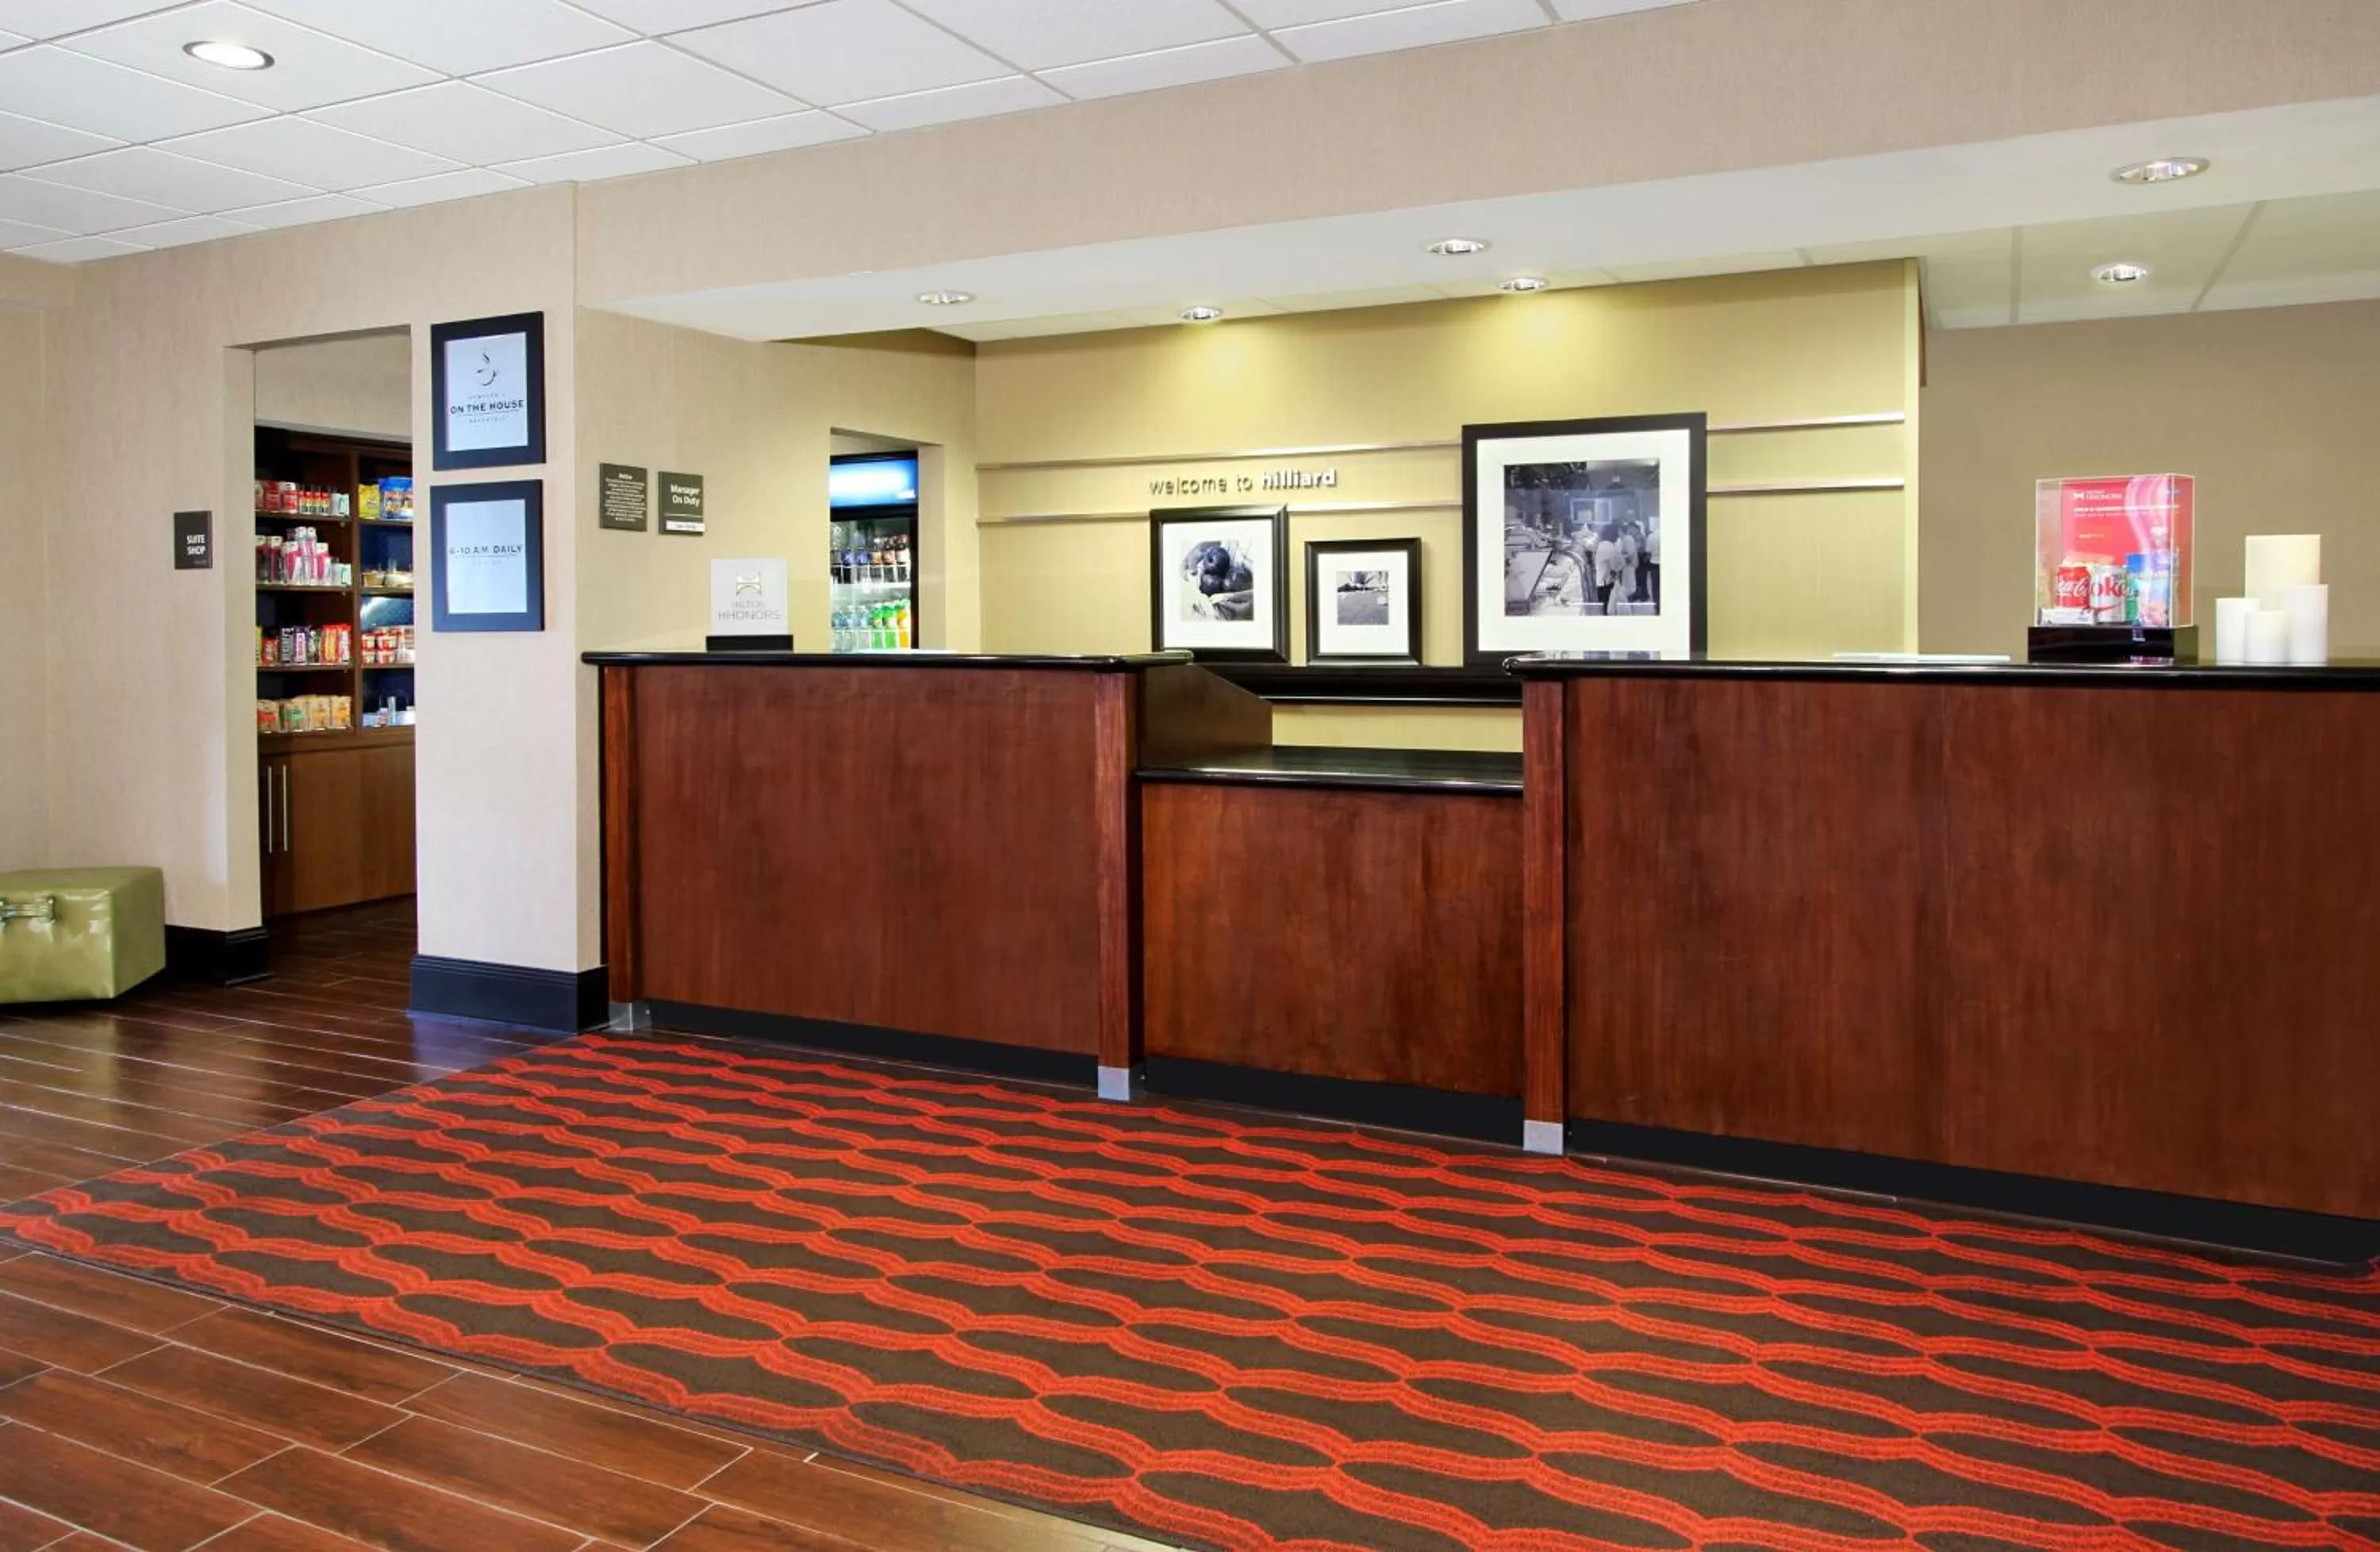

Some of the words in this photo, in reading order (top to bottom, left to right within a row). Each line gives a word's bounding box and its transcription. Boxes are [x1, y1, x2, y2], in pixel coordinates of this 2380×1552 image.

[450, 405, 464, 414] ON
[466, 402, 486, 413] THE
[489, 399, 524, 410] HOUSE
[1150, 477, 1227, 495] welcome
[1237, 474, 1253, 492] to
[1262, 469, 1338, 490] hilliard
[670, 483, 700, 497] Manager
[672, 494, 683, 504] On
[683, 495, 701, 508] Duty
[186, 534, 205, 544] SUITE
[186, 545, 206, 555] SHOP
[493, 544, 522, 554] DAILY
